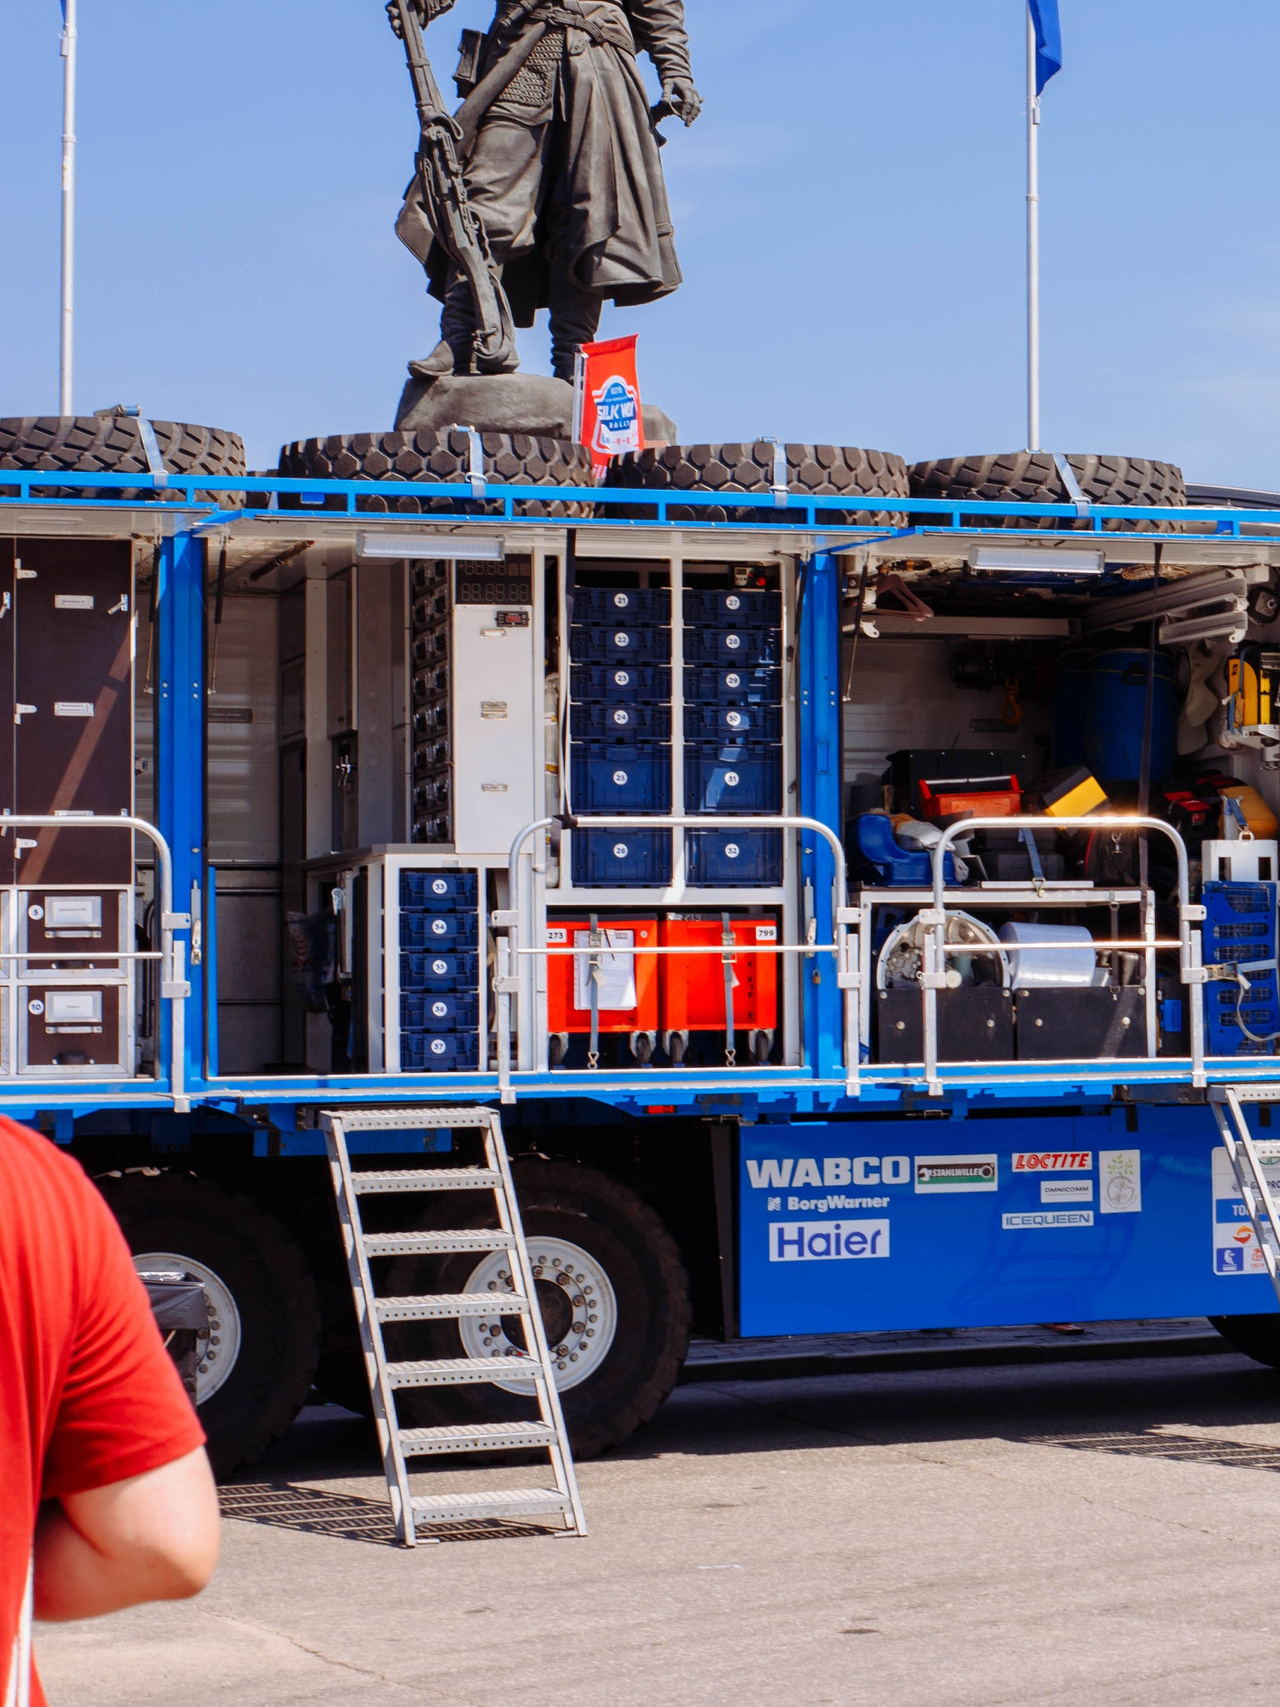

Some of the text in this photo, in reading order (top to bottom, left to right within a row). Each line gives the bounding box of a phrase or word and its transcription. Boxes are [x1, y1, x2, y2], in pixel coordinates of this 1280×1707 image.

[596, 403, 620, 421] SILK
[549, 931, 563, 939] 273
[759, 929, 774, 937] 799
[1014, 1153, 1089, 1170] LOCTITE
[746, 1155, 910, 1188] WABCO
[787, 1195, 890, 1212] BorgWarner
[1005, 1214, 1090, 1227] ICEQUEEN
[777, 1223, 881, 1257] Haier
